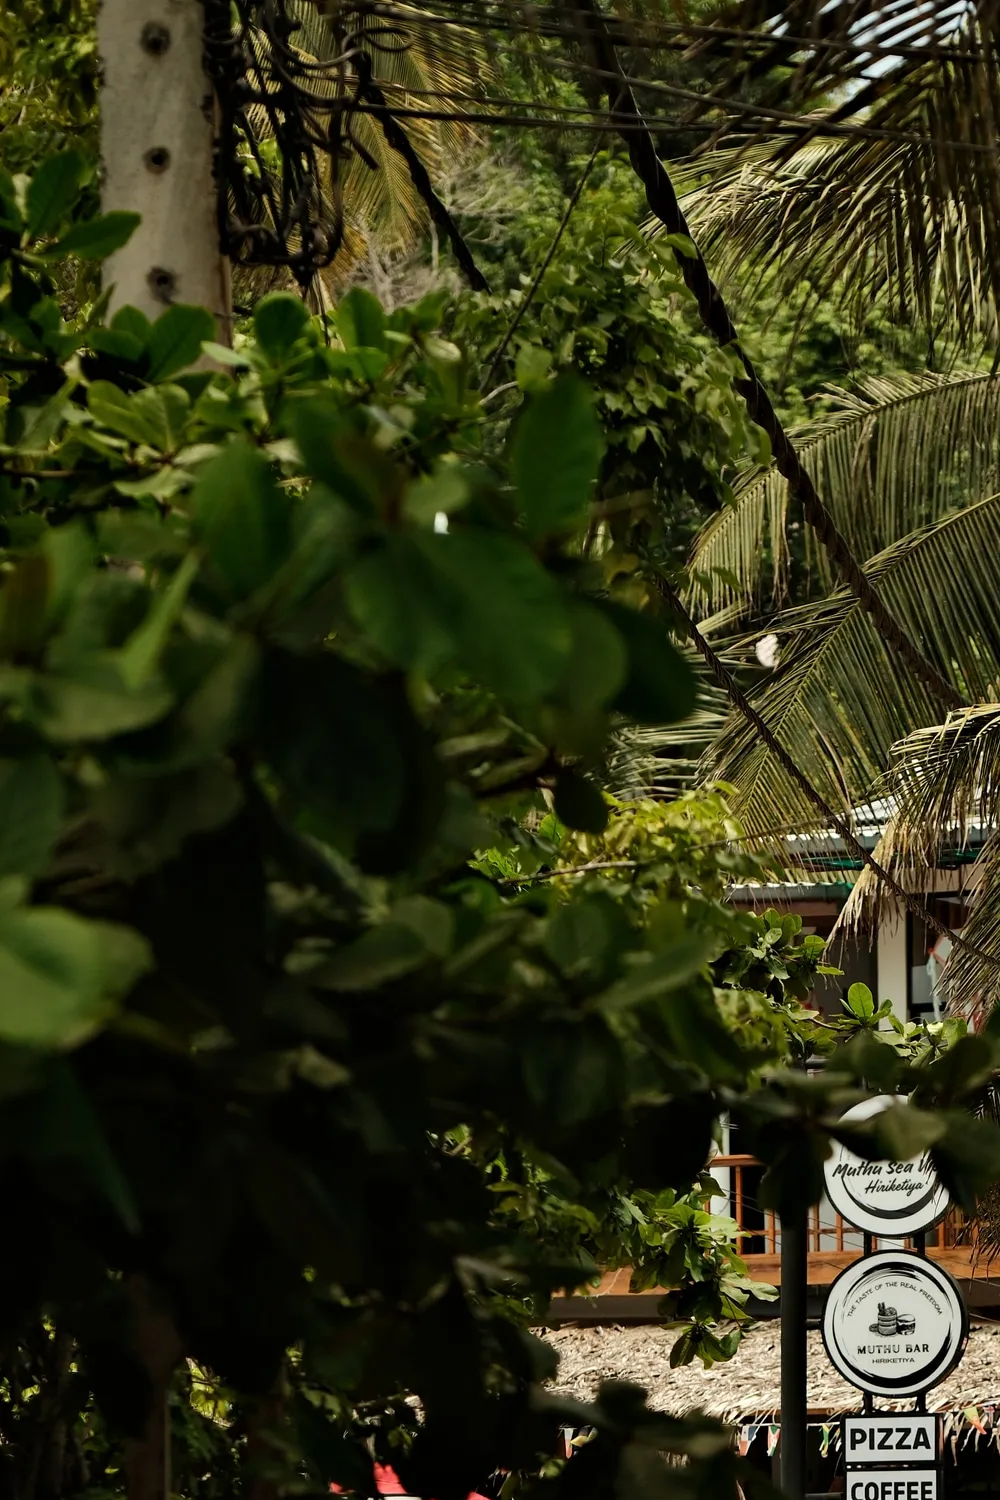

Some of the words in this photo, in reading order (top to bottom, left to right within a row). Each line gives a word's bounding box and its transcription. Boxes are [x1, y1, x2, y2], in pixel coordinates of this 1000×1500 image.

[832, 1160, 882, 1178] Muthu
[886, 1160, 914, 1175] Sea
[865, 1178, 924, 1197] Hiriketiya
[847, 1305, 856, 1317] THE
[855, 1288, 874, 1305] TASTE
[874, 1283, 883, 1291] OF
[900, 1281, 918, 1292] REAL
[918, 1288, 943, 1315] FREEDOM
[857, 1345, 900, 1354] MUTHU
[905, 1344, 930, 1353] BAR
[850, 1427, 931, 1450] PIZZA
